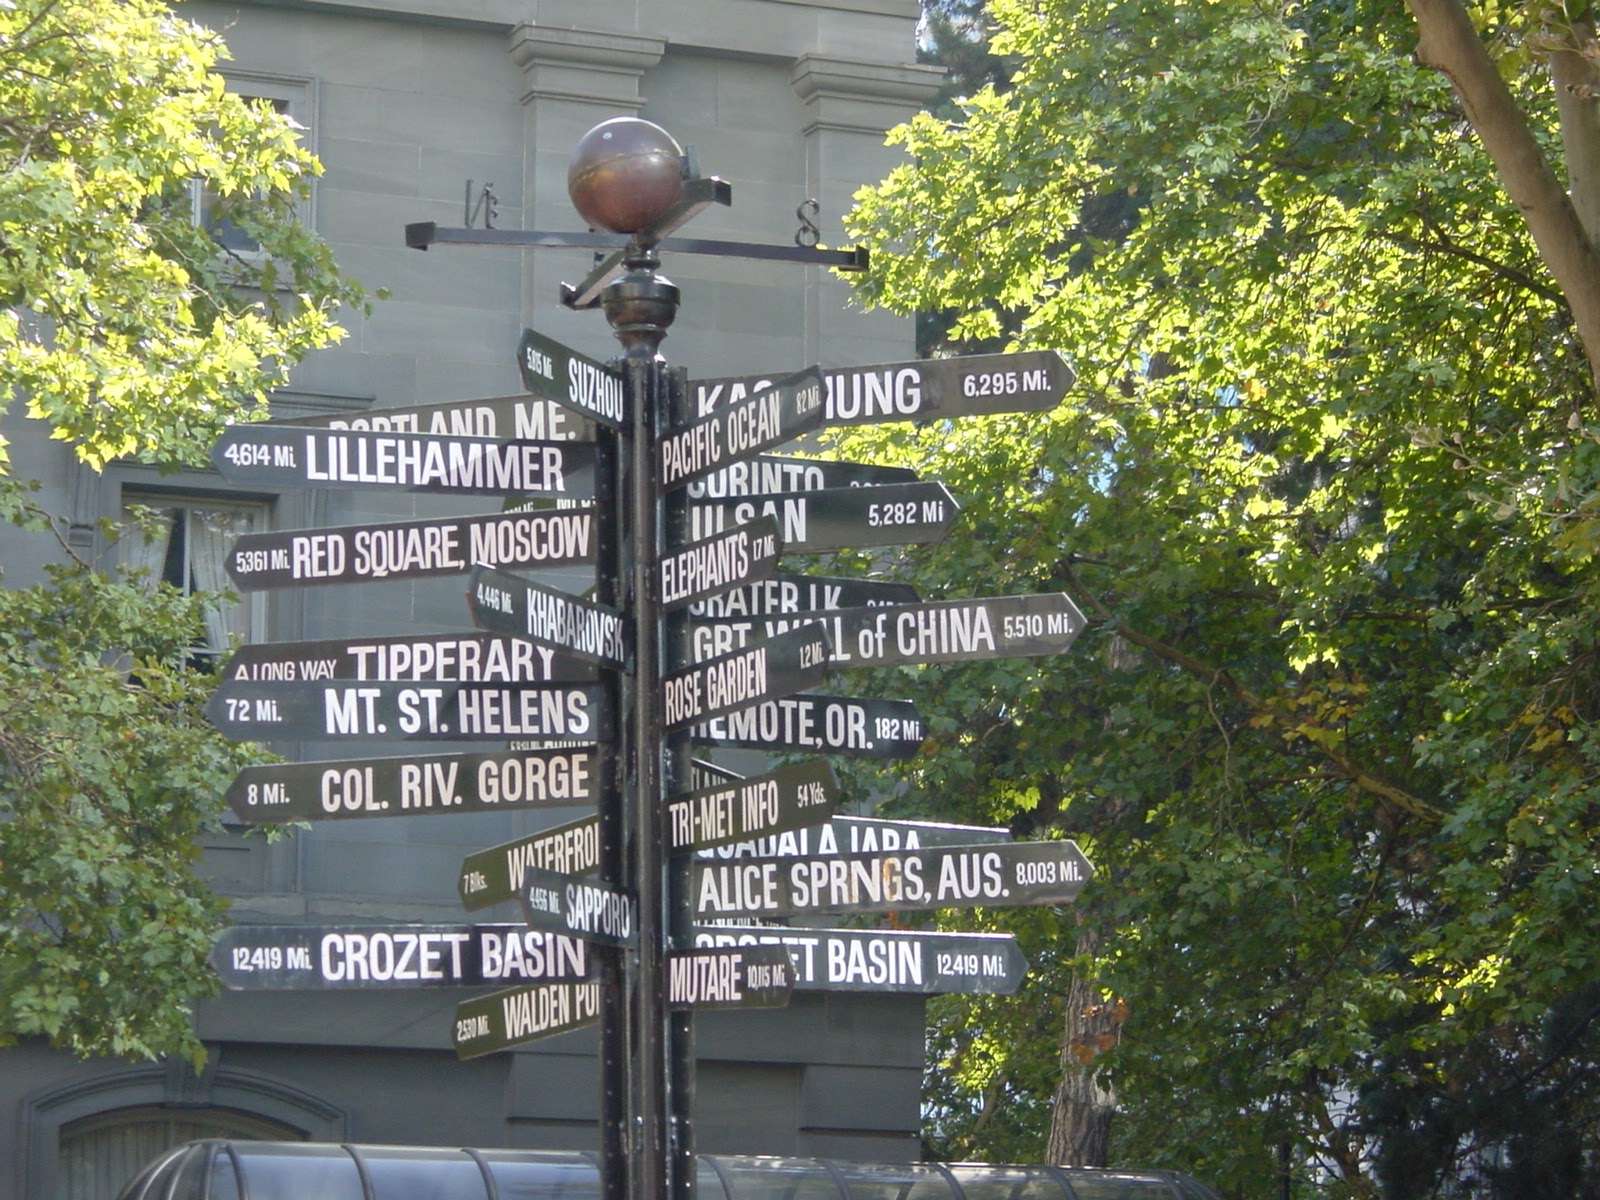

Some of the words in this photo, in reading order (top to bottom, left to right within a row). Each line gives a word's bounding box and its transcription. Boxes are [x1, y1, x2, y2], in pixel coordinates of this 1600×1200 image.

[568, 357, 623, 422] SUZHOU
[963, 373, 1018, 397] 6,295
[1023, 369, 1051, 392] Mi.
[515, 400, 576, 439] ME.
[662, 418, 721, 484] PACIFIC
[727, 390, 781, 455] OCEAN
[796, 391, 807, 415] 82
[224, 443, 271, 466] 4,614
[274, 445, 297, 469] Mi.
[306, 435, 565, 492] LILLEHAMMER
[869, 504, 917, 527] 5,282
[236, 550, 268, 574] 5,361
[271, 549, 291, 570] Mi.
[293, 534, 346, 579] RED
[355, 526, 466, 577] SQUARE,
[470, 515, 590, 570] MOSCOW
[662, 531, 748, 604] ELEPHANTS
[527, 588, 624, 662] KHABAROVSK
[858, 614, 887, 660] of
[897, 606, 996, 657] CHINA
[1048, 613, 1074, 635] Mi.
[234, 664, 250, 681] A
[299, 659, 338, 681] WAY
[347, 638, 555, 682] TIPPERARY
[665, 674, 702, 726] ROSE
[707, 648, 767, 710] GARDEN
[225, 698, 250, 721] 72
[256, 699, 282, 721] Mi.
[324, 688, 388, 735] MT.
[398, 687, 449, 735] ST.
[457, 689, 591, 735] HELENS
[875, 716, 900, 740] 182
[903, 718, 924, 742] Mi.
[247, 783, 258, 806] 8
[263, 782, 291, 805] Mi.
[321, 768, 389, 814] COL.
[400, 762, 463, 809] RIV.
[477, 753, 590, 804] GORGE
[669, 790, 736, 847] TRI-MET
[741, 780, 779, 832] INFO
[797, 785, 809, 808] 54
[697, 823, 921, 859] DALAJARA
[463, 874, 470, 895] 7
[699, 863, 778, 912] ALICE
[937, 852, 1010, 900] AUS.
[1015, 862, 1056, 885] 8,003
[1059, 861, 1083, 882] Mi.
[566, 884, 631, 939] SAPPORO
[233, 947, 282, 972] 12,419
[286, 947, 313, 970] Mi.
[321, 933, 469, 981] CROZET
[481, 931, 585, 979] BASIN
[670, 954, 742, 1003] MUTARE
[828, 938, 923, 985] BASIN
[936, 953, 979, 976] 12,419
[982, 955, 1006, 977] Mi.
[503, 985, 570, 1040] WALDEN
